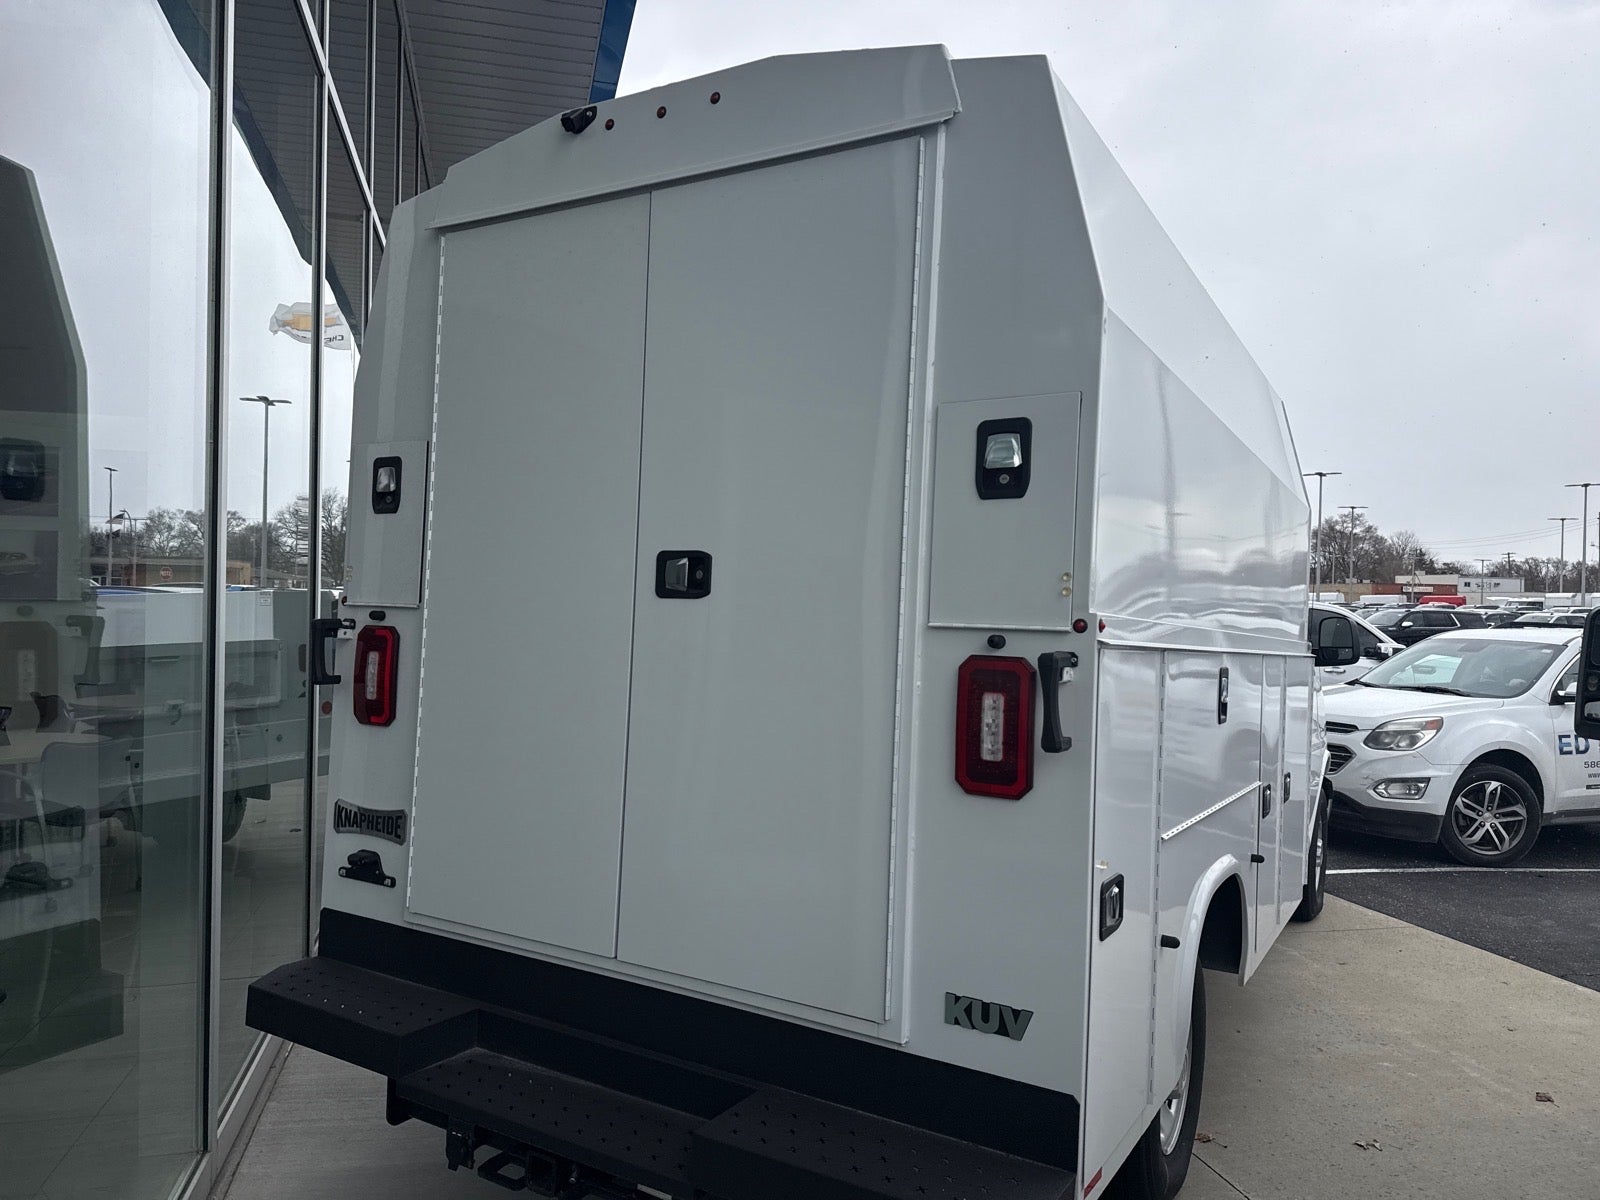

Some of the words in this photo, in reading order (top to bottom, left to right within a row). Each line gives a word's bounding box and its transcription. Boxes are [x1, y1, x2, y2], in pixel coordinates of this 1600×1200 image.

[1558, 734, 1590, 755] ED
[336, 804, 403, 840] KNAPHEIDE
[944, 992, 1034, 1041] KUV
